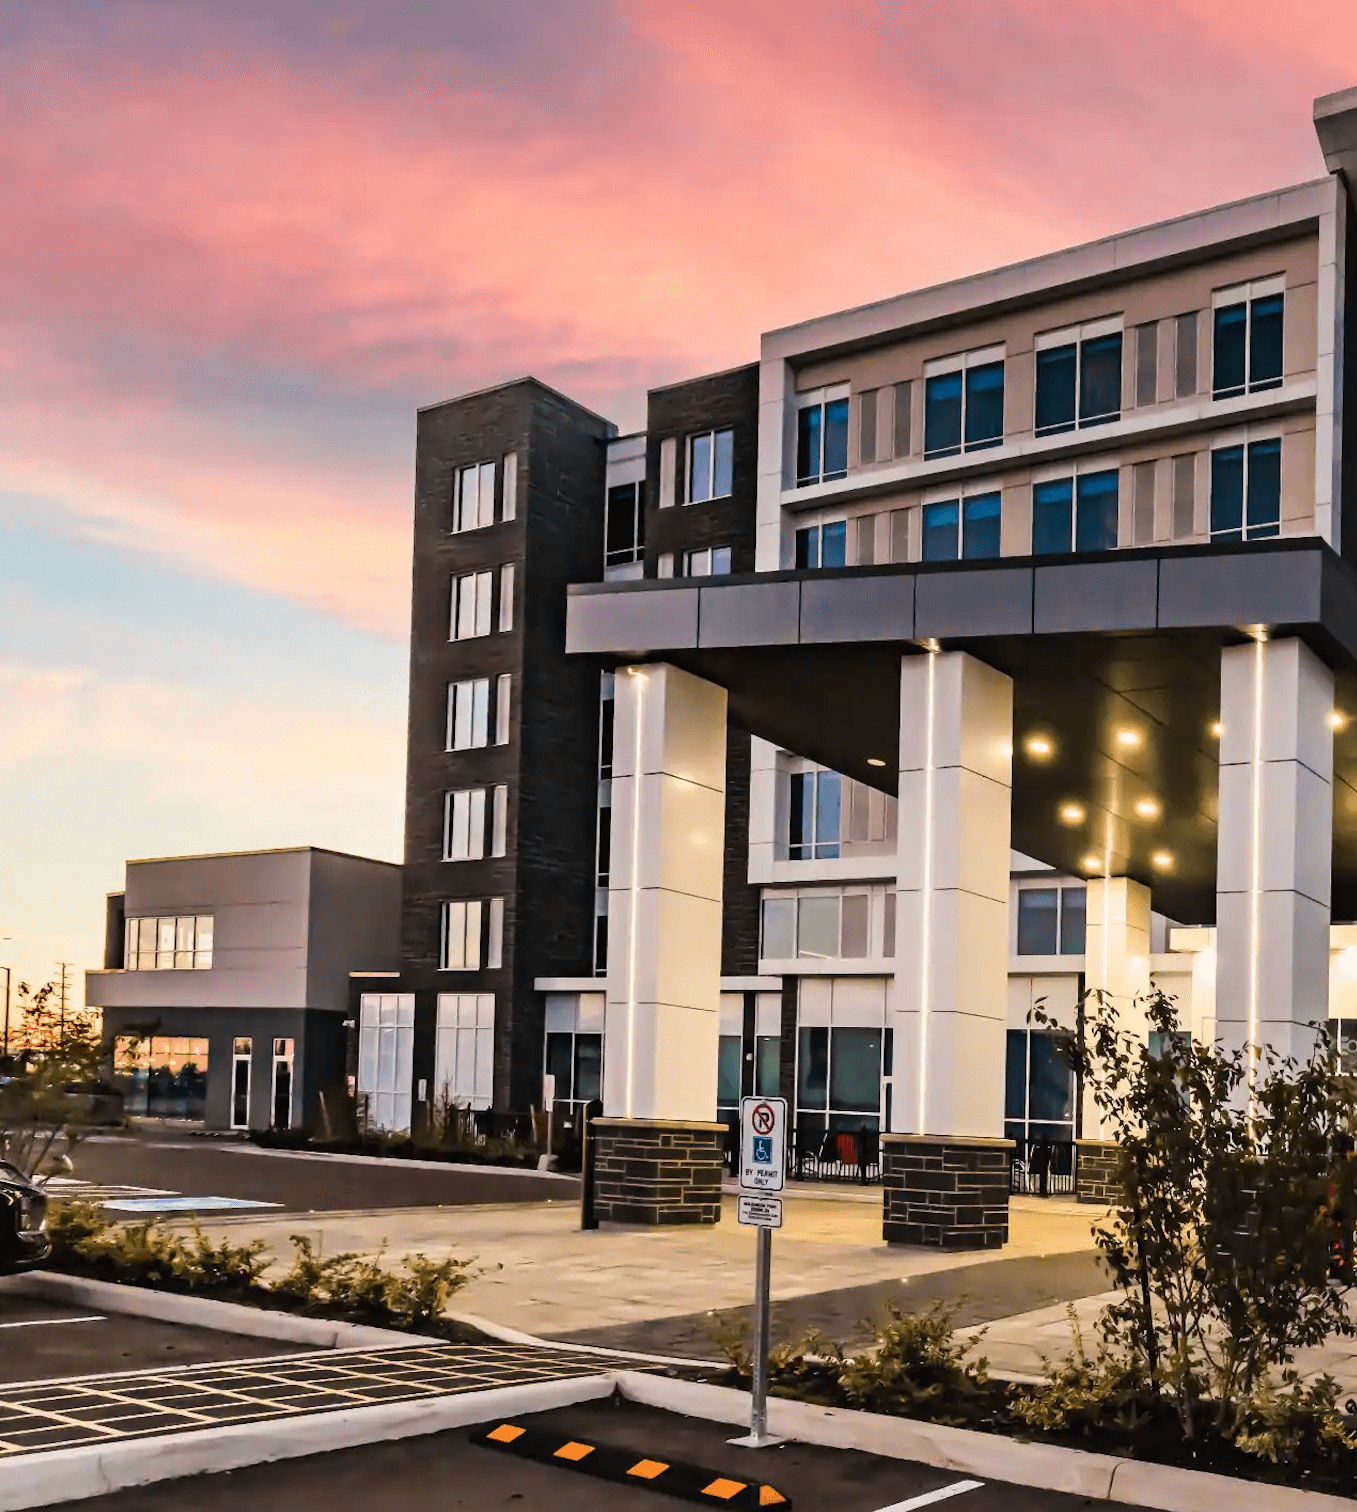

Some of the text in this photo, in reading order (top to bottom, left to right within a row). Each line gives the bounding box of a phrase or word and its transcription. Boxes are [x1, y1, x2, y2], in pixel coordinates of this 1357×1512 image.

[745, 1168, 778, 1179] BY PERMIT
[754, 1177, 769, 1186] ONLY
